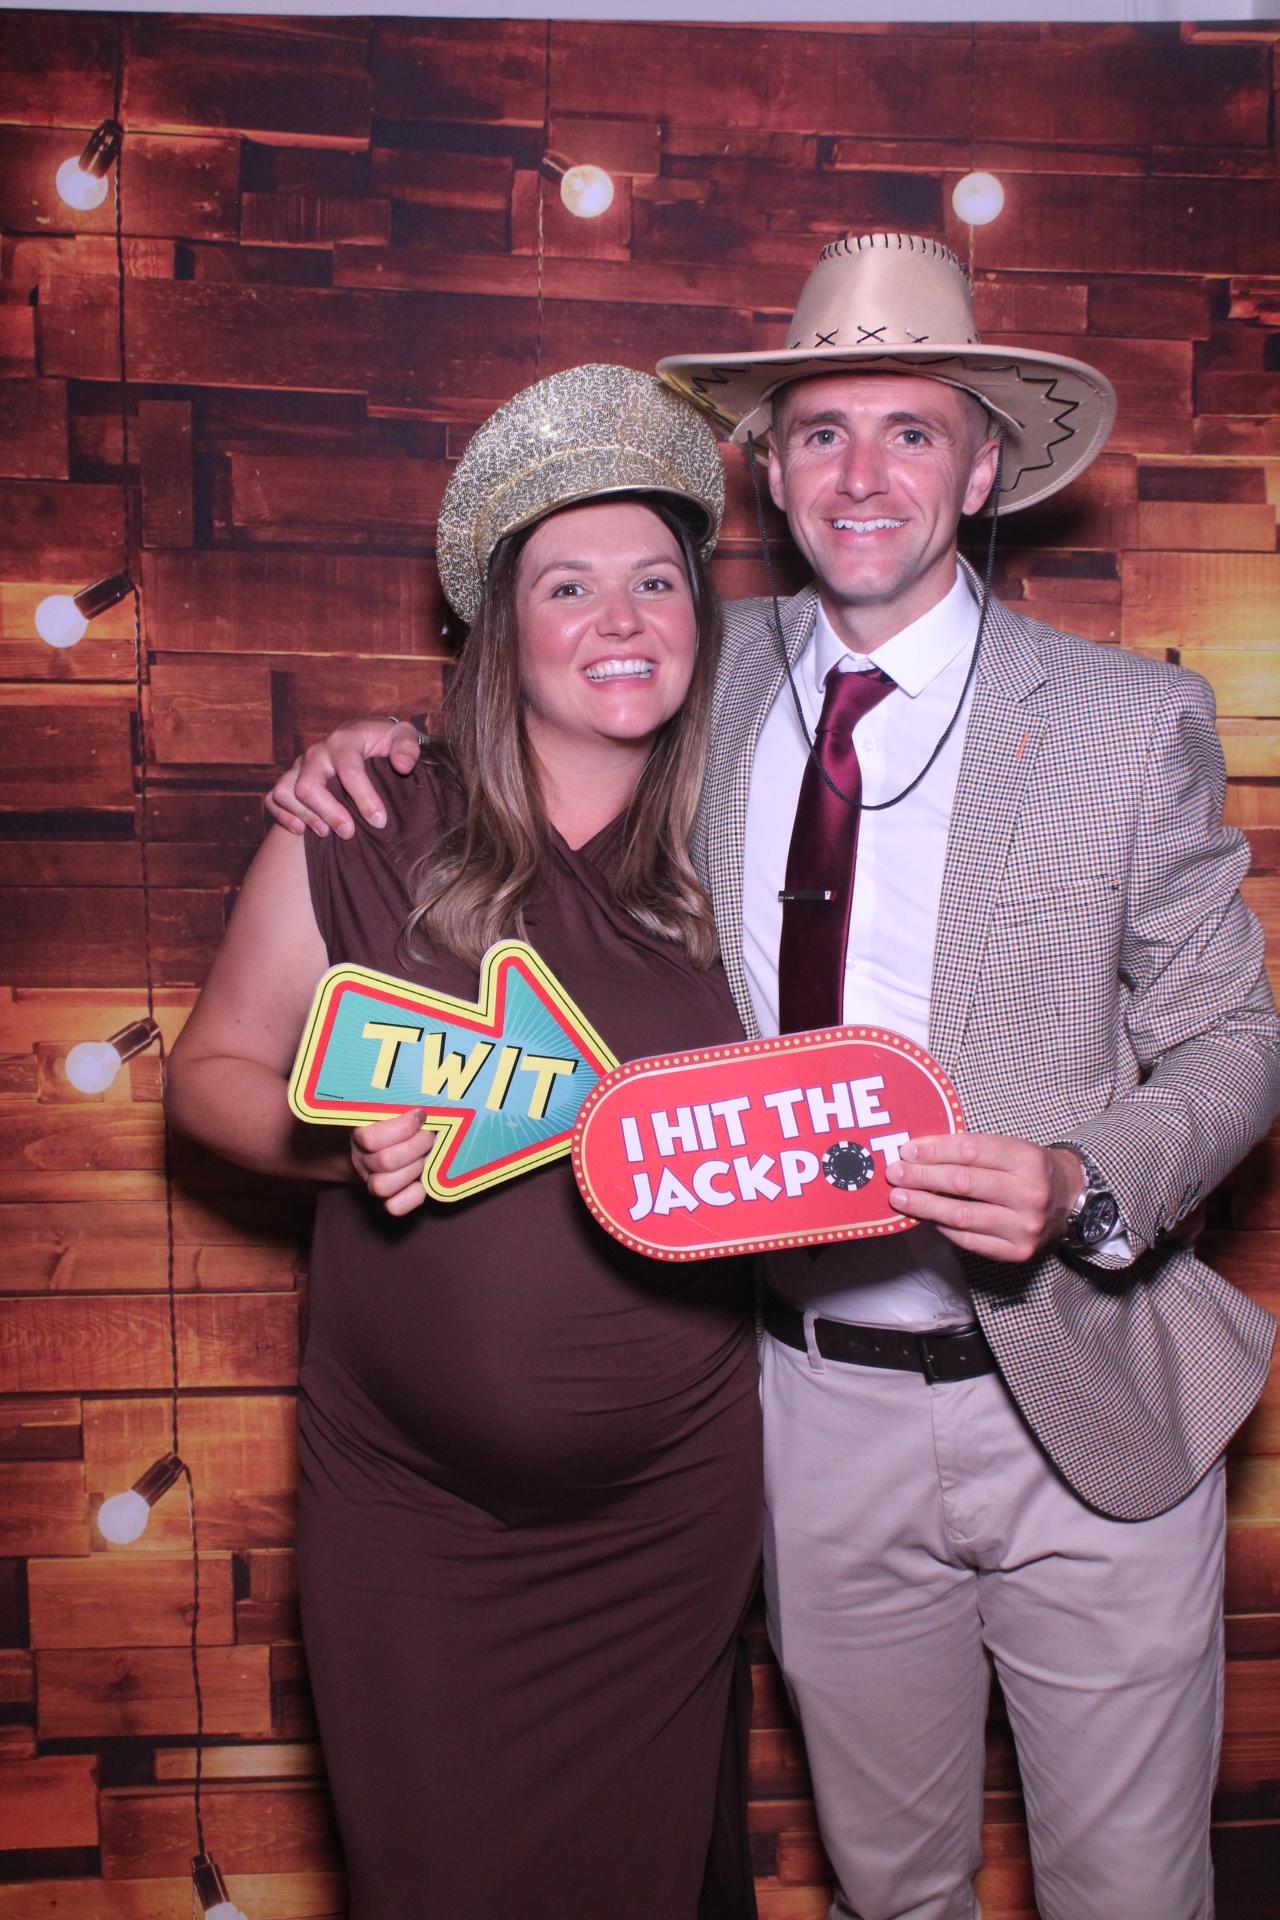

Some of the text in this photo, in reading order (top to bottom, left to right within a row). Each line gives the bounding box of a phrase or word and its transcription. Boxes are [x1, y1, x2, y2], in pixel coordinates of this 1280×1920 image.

[361, 1021, 579, 1120] TWIT
[621, 1075, 891, 1162] I HIT THE
